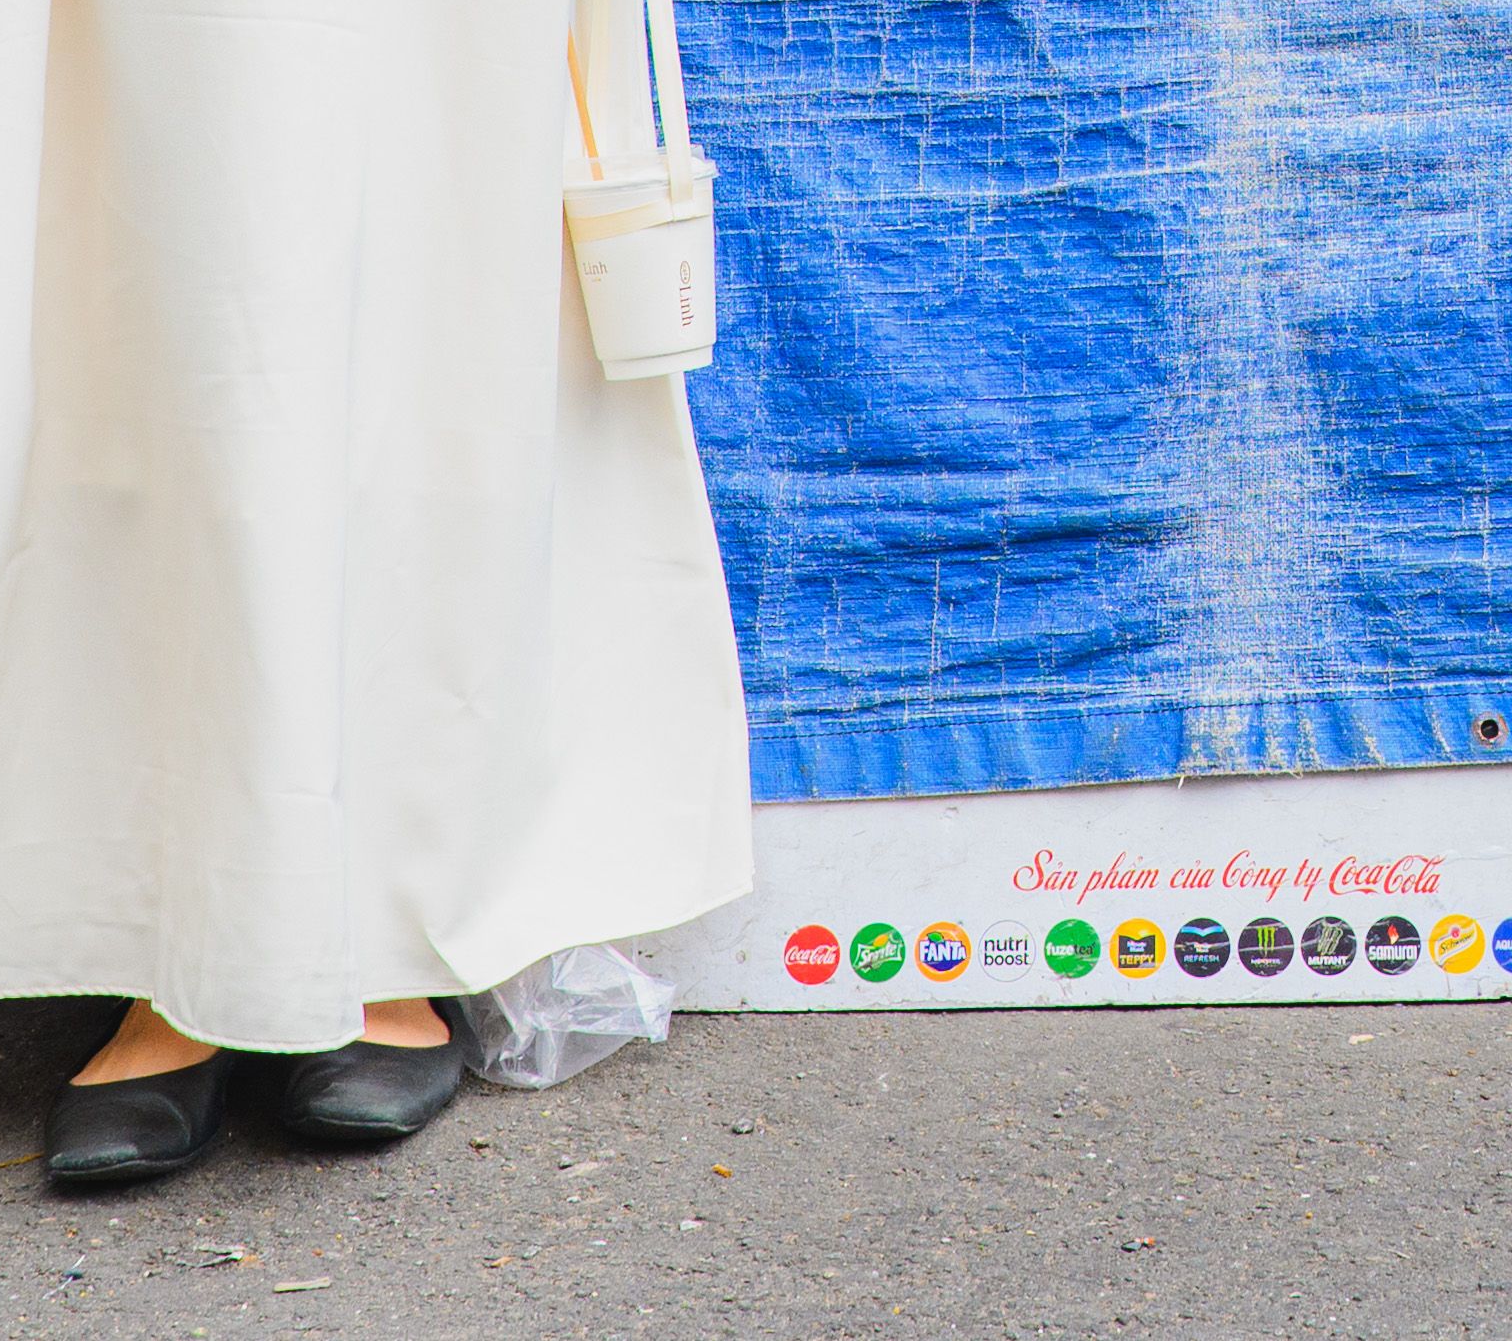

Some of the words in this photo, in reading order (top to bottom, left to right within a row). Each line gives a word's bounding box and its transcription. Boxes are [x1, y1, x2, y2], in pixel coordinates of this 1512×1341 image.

[582, 261, 609, 276] Linh
[678, 285, 695, 327] Linh
[1012, 849, 1079, 892] Sản
[1075, 850, 1161, 906] phẩm
[1168, 858, 1215, 890] của
[1220, 849, 1289, 903] Công
[1291, 858, 1323, 902] ty
[983, 934, 1029, 952] nutri
[983, 951, 1031, 967] boost
[1306, 955, 1349, 967] MUTANT
